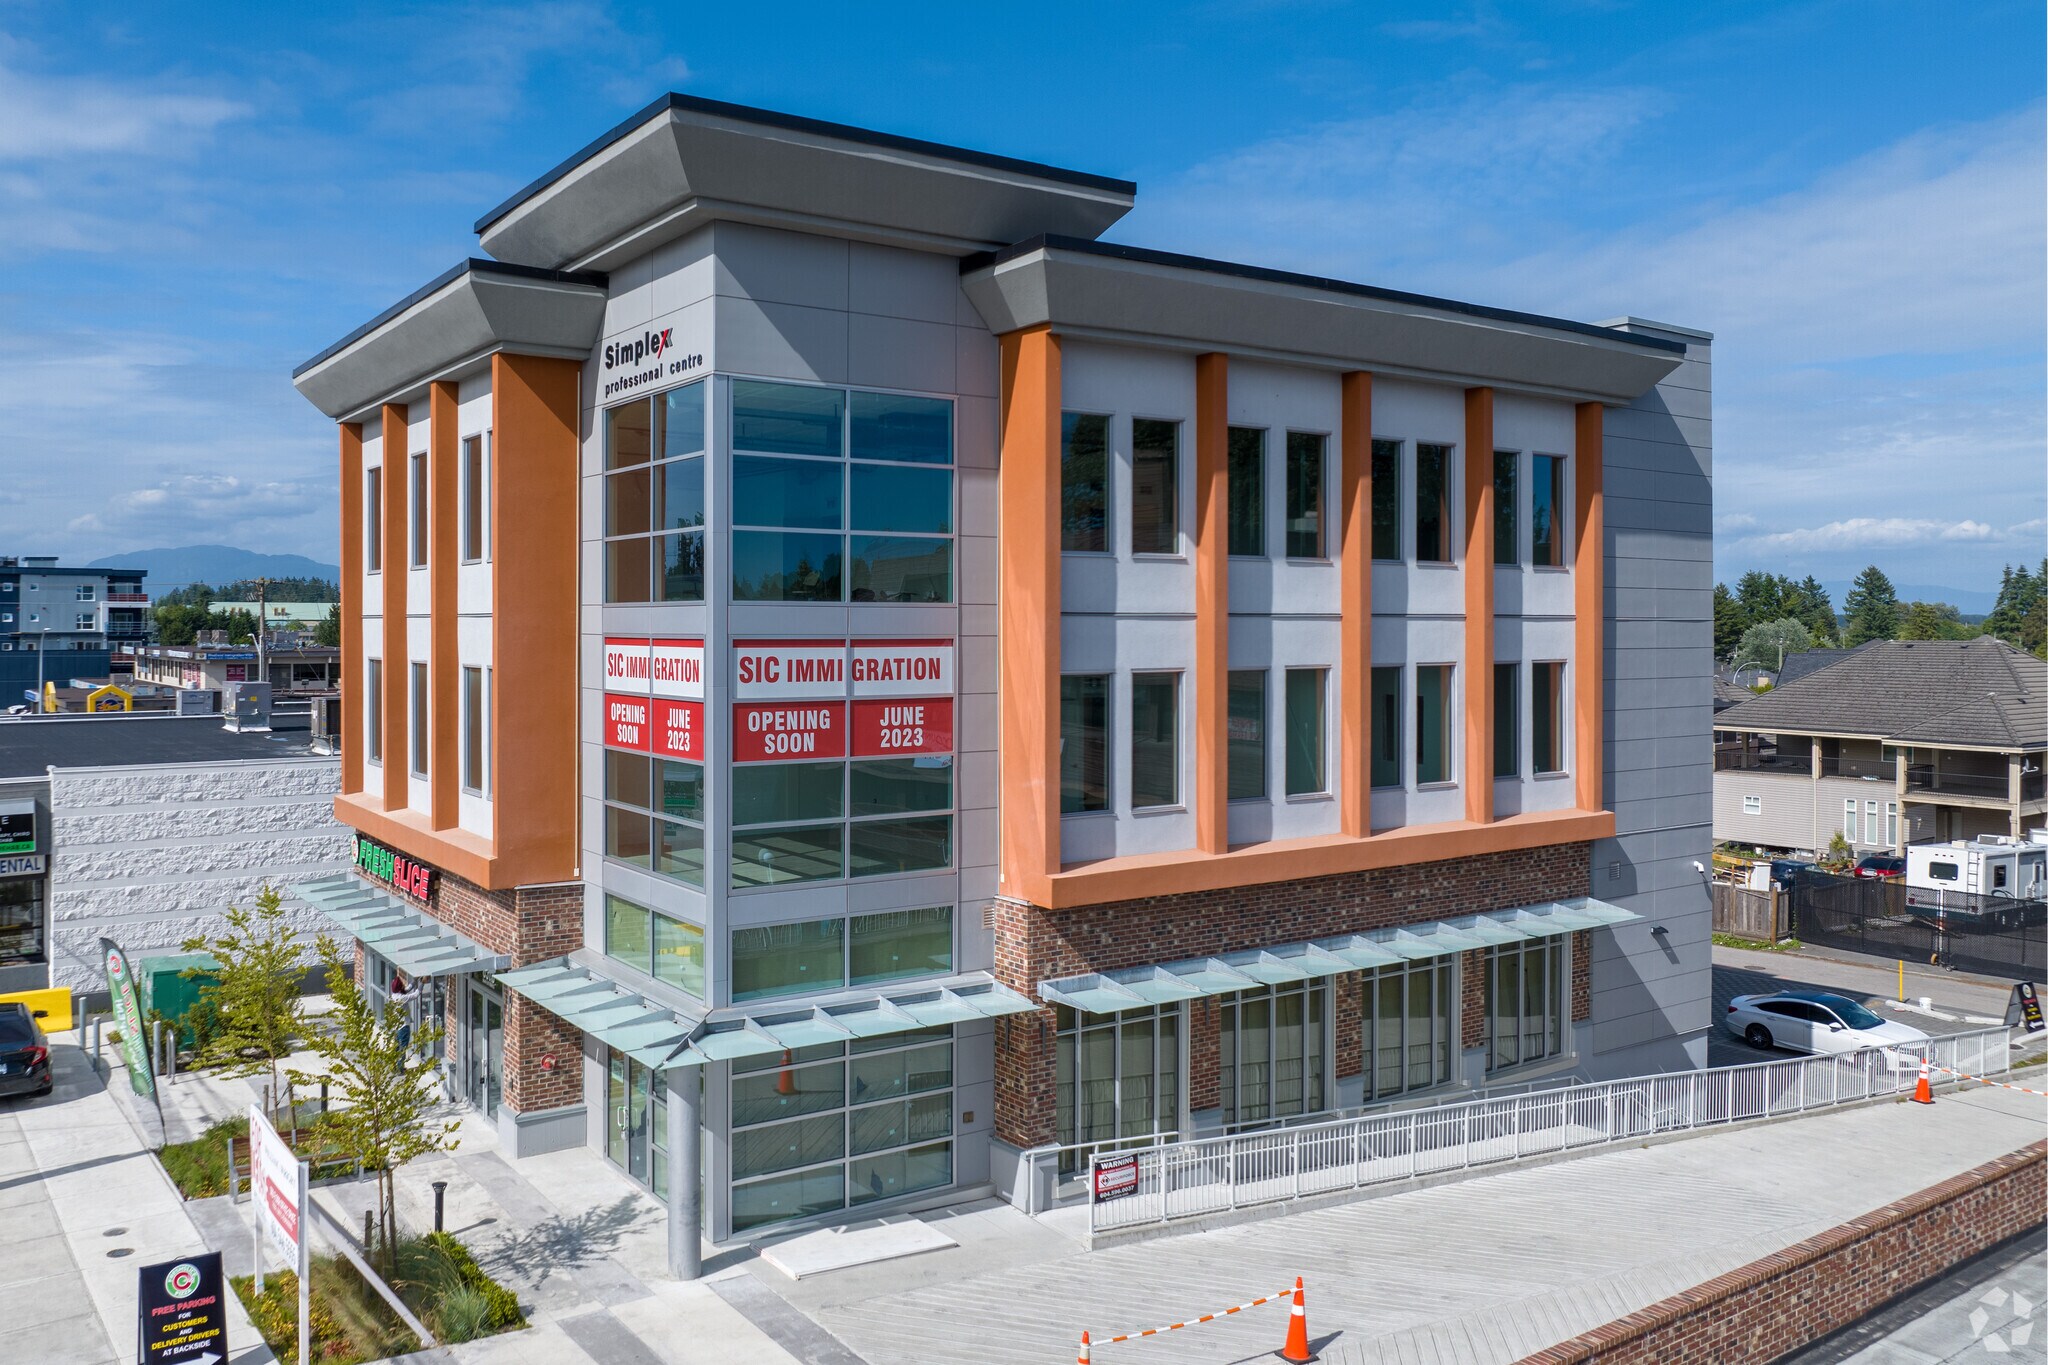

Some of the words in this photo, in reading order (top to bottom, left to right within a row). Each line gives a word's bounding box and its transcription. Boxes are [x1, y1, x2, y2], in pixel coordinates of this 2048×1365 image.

[605, 328, 673, 369] Simplex
[605, 363, 663, 398] professional
[670, 354, 703, 375] centre
[608, 652, 624, 677] SIC
[739, 656, 780, 683] SIC
[611, 703, 645, 725] OPENING
[667, 708, 690, 729] JUNE
[748, 709, 831, 732] OPENING
[880, 706, 924, 727] JUNE
[617, 723, 638, 745] SOON
[667, 730, 690, 752] 2023
[764, 732, 815, 754] SOON
[880, 727, 924, 748] 2023
[1101, 1156, 1134, 1170] WARNING
[151, 1304, 176, 1317] FREE
[177, 1295, 216, 1311] PARKING
[178, 1311, 192, 1319] FOR
[162, 1316, 208, 1332] CUSTOMERS
[179, 1327, 193, 1336] AND
[151, 1335, 187, 1351] DELIVERY
[188, 1328, 220, 1343] DRIVERS
[162, 1348, 172, 1357] AT
[173, 1339, 211, 1354] BACKSIDE
